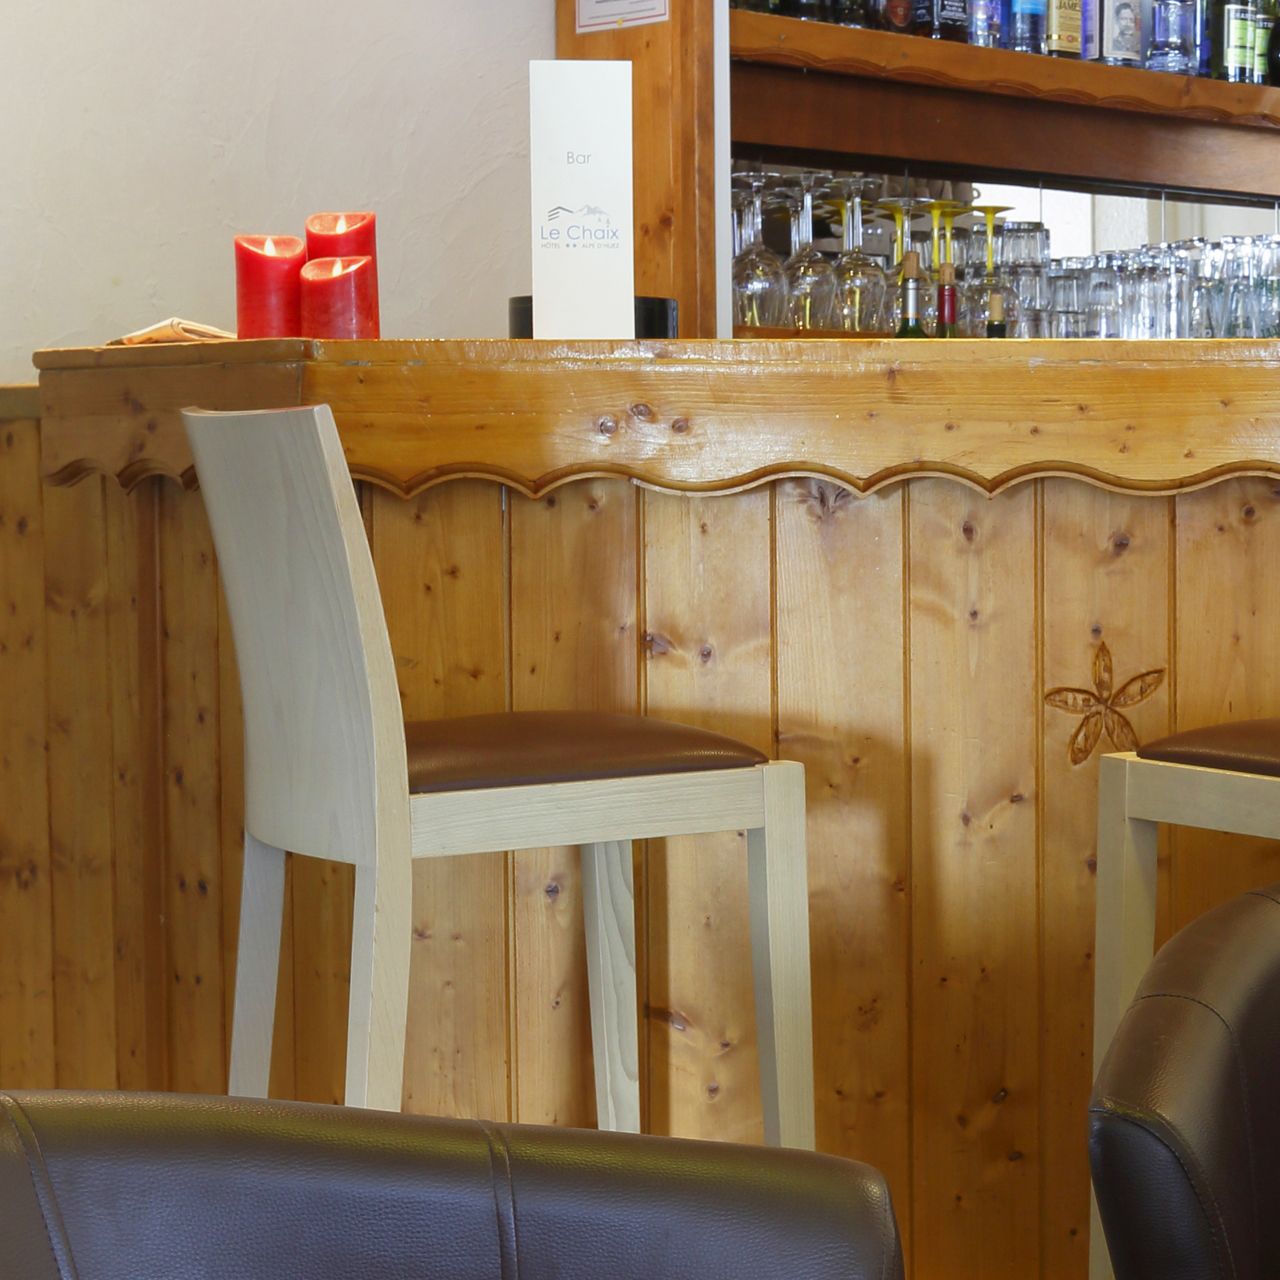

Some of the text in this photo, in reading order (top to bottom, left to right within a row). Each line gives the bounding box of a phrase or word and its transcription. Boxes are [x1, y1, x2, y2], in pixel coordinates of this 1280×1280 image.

[566, 151, 592, 165] Bar
[540, 223, 619, 241] Le Chaix
